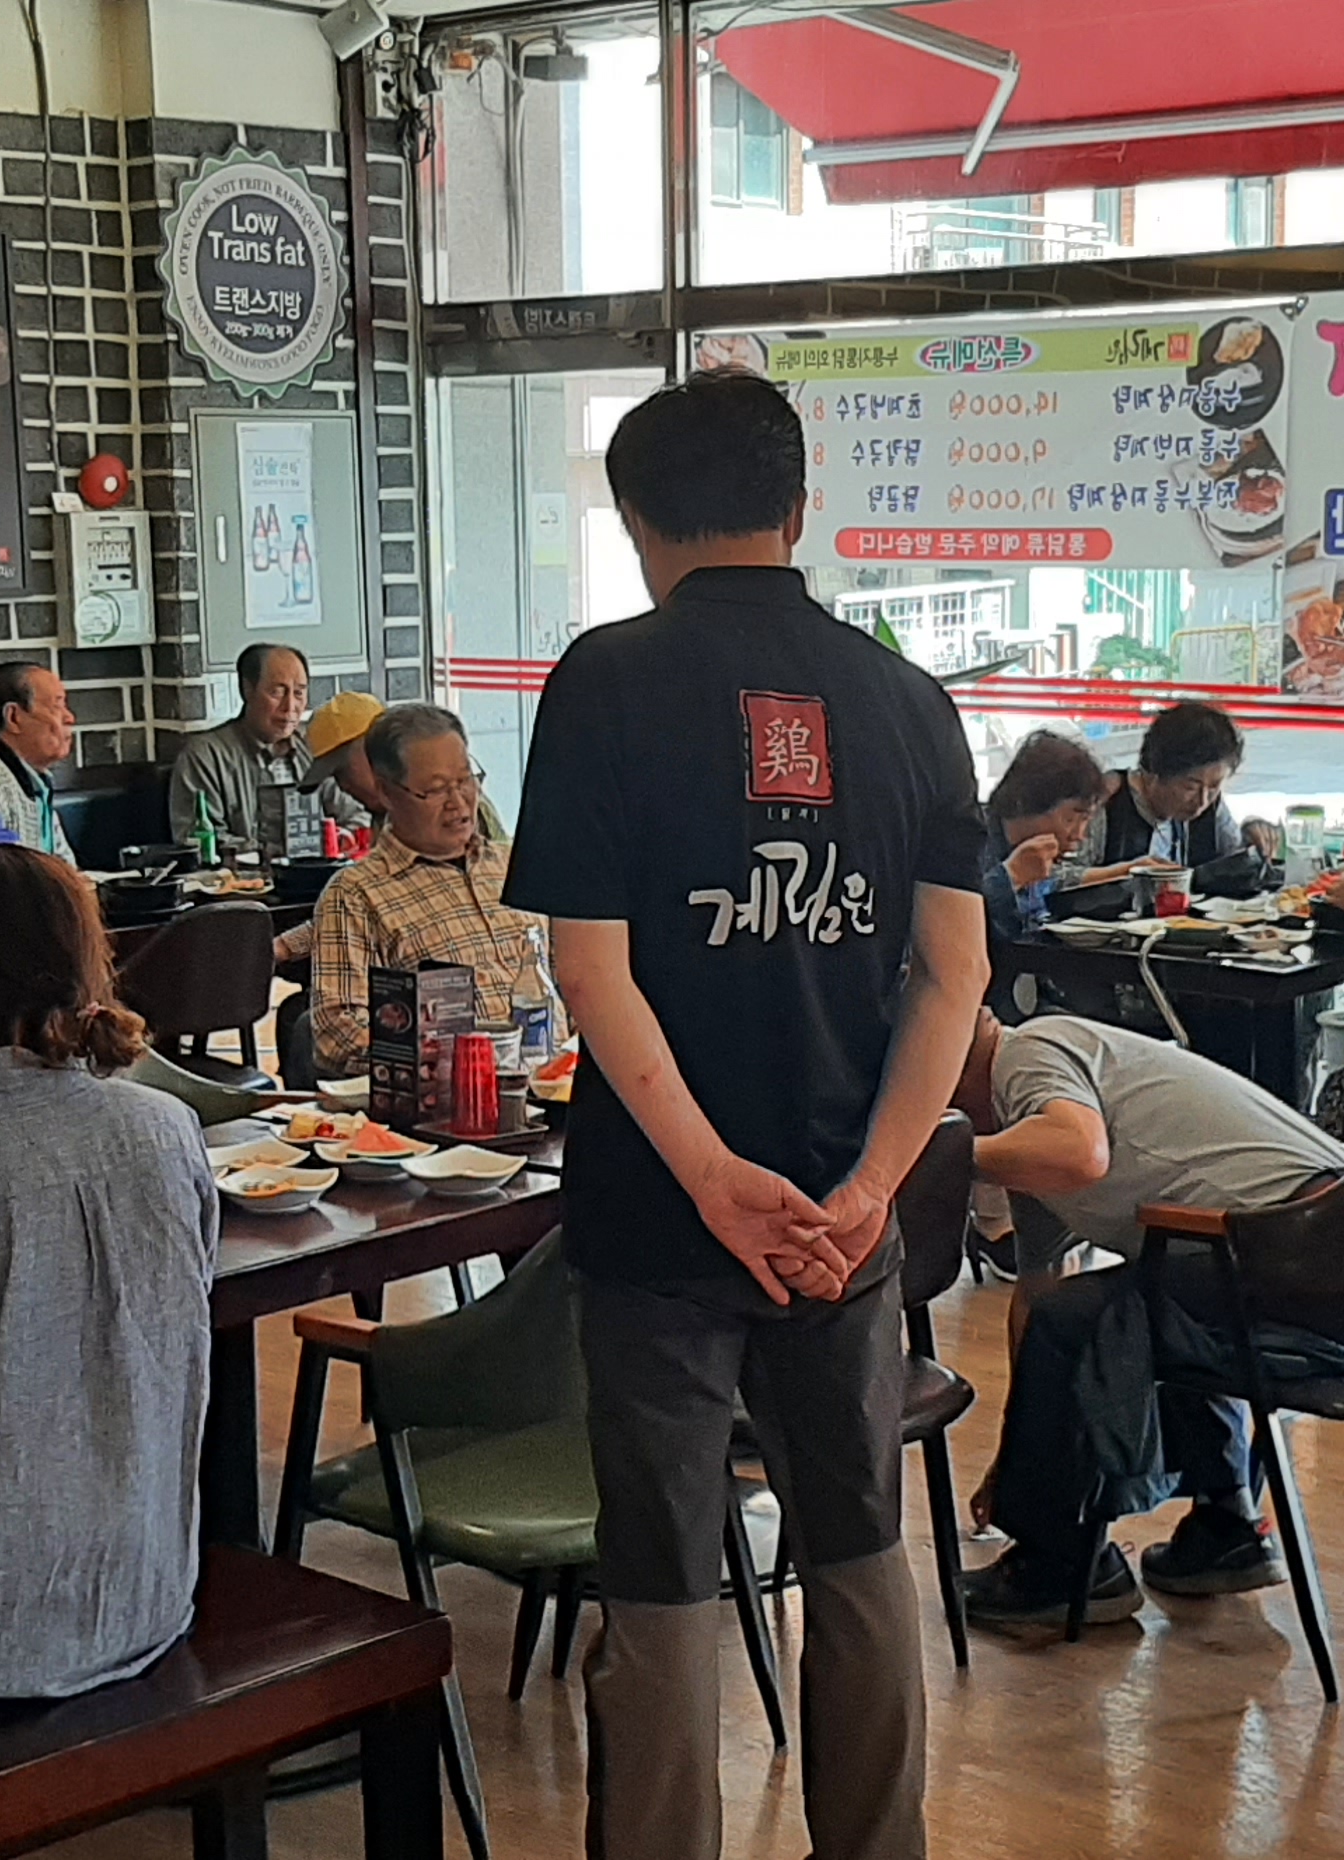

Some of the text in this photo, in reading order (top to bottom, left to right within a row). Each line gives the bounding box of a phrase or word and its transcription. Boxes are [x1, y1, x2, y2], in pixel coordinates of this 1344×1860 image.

[232, 204, 279, 237] Low
[208, 231, 307, 267] Trans fat
[214, 286, 303, 321] 트랜스지방
[688, 841, 877, 946] 계림원
